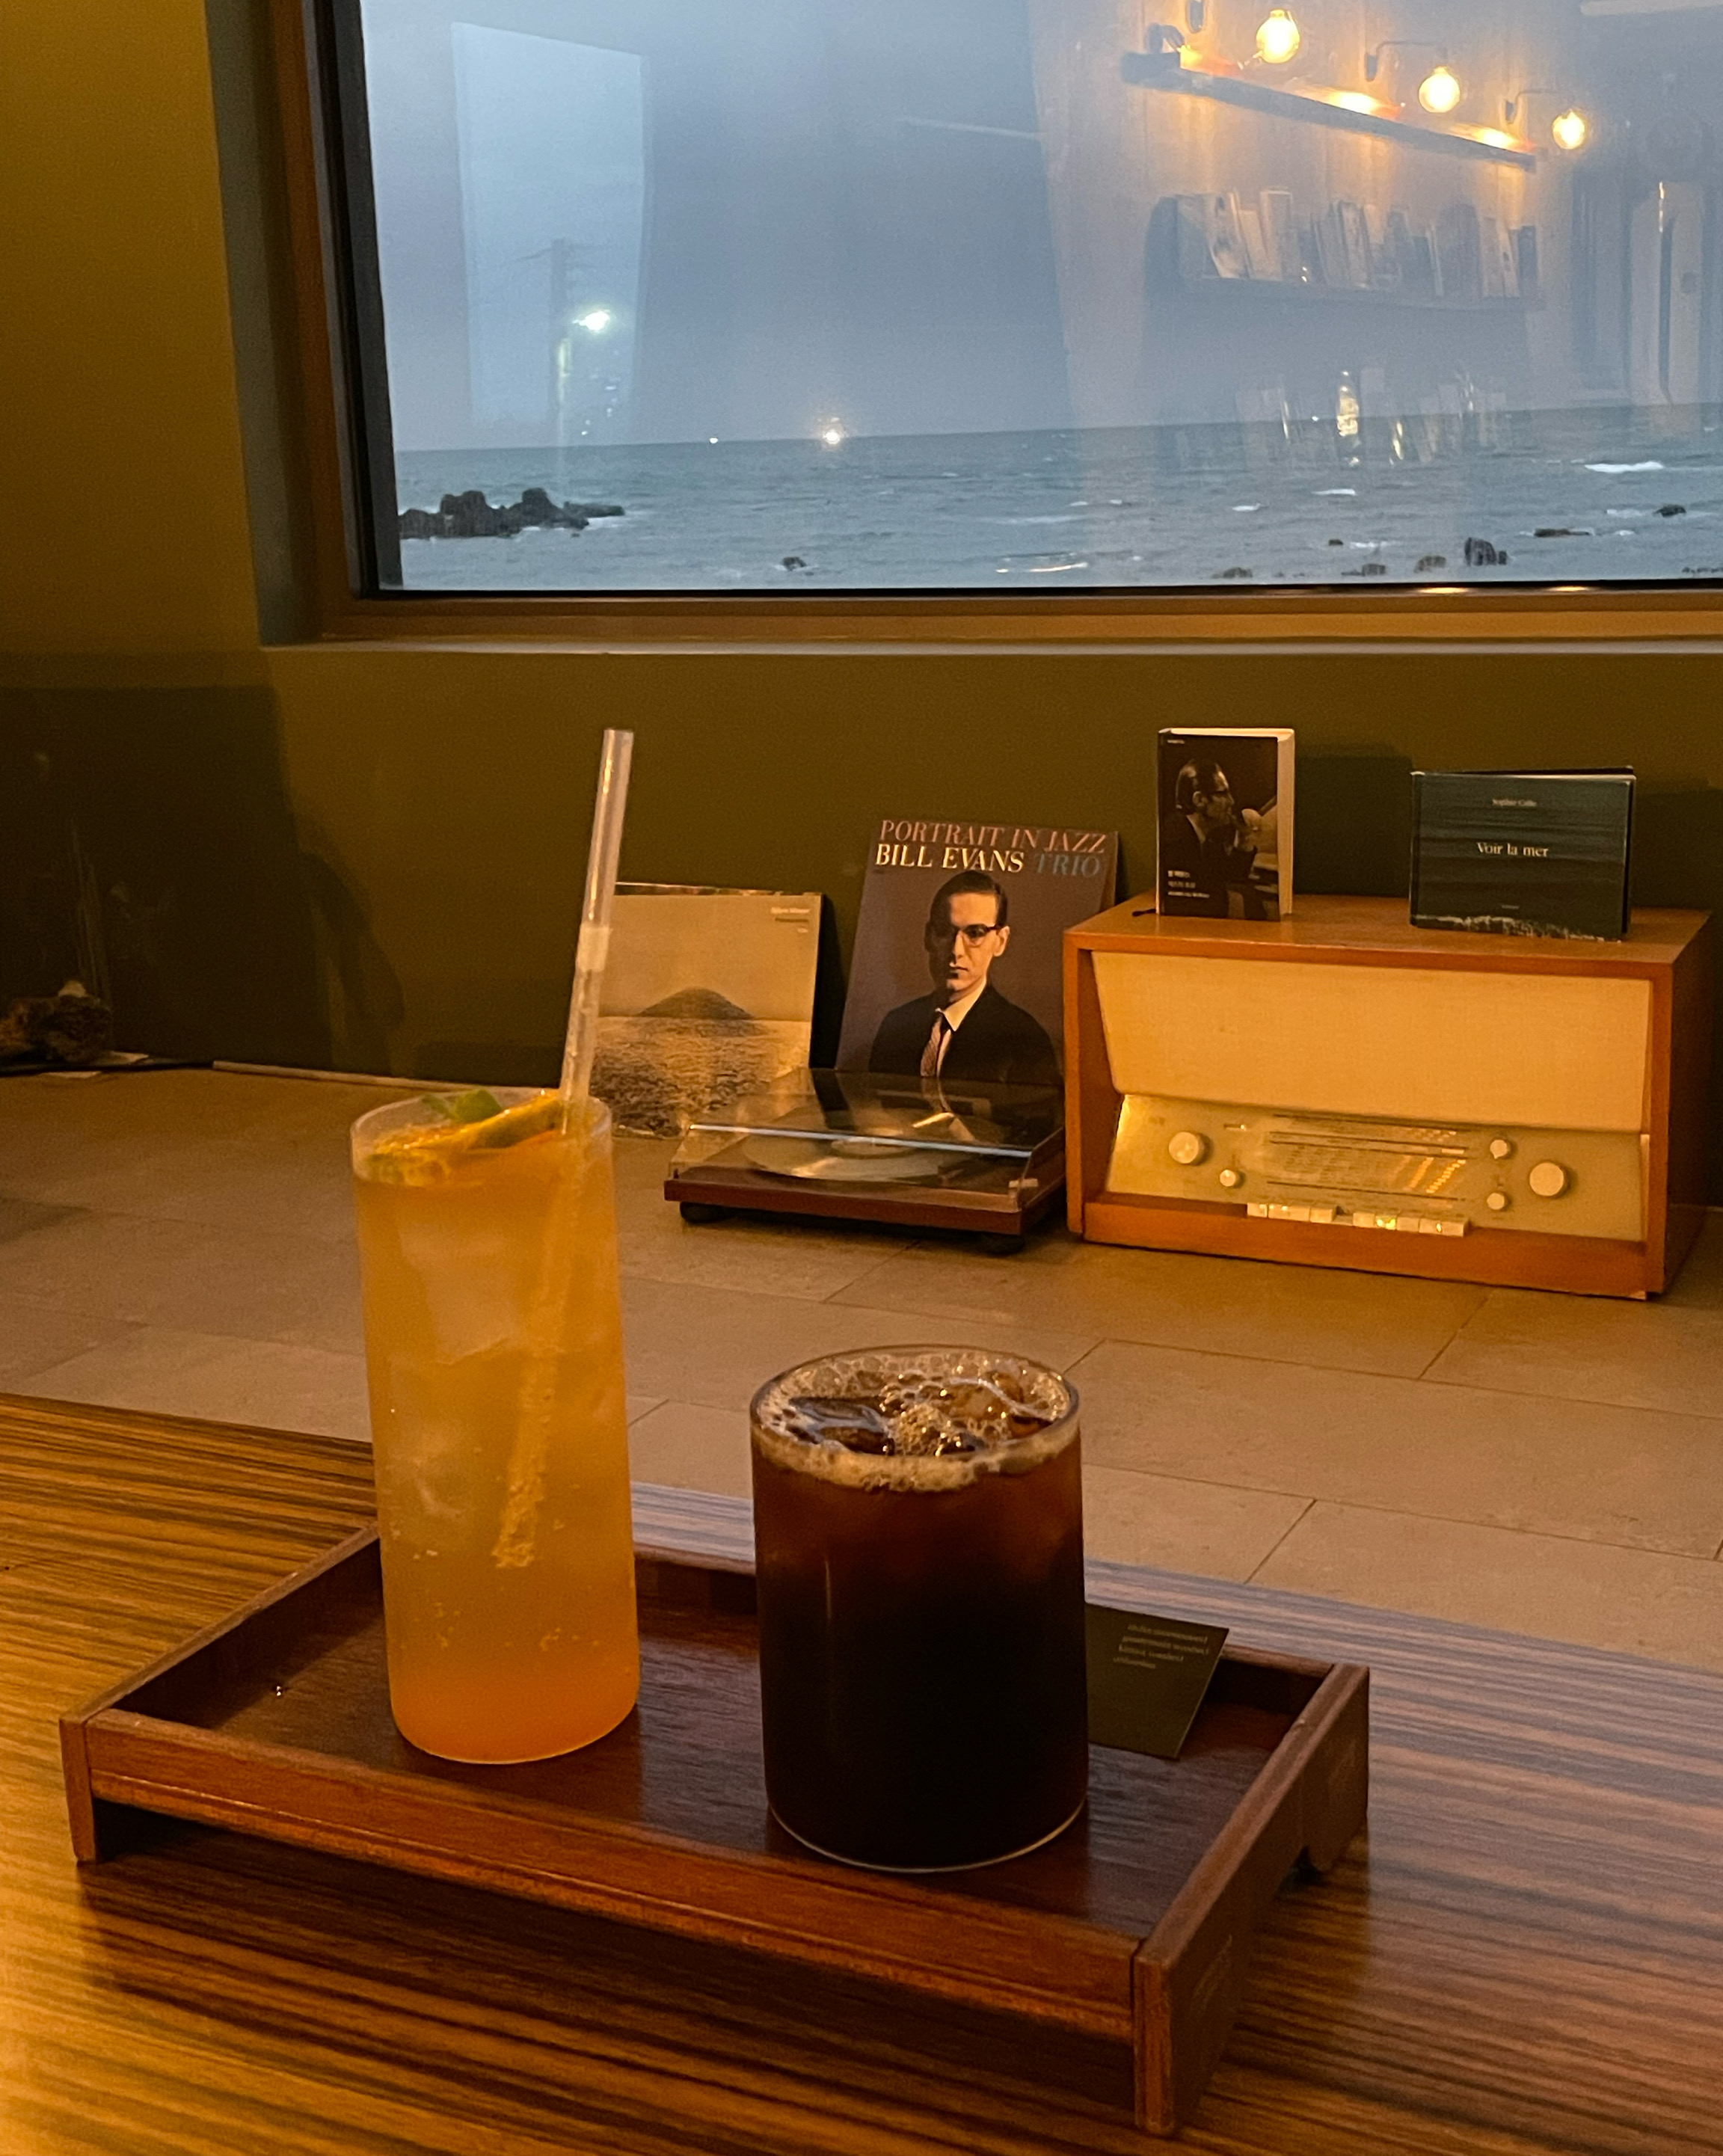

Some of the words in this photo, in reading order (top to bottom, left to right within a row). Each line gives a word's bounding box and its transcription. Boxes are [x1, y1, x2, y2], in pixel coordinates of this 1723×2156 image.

[880, 820, 1004, 847] PORTRAIT
[1011, 828, 1038, 848] IN
[1043, 831, 1107, 854] JAZZ
[1476, 842, 1503, 855] Voir
[1507, 843, 1518, 856] la
[1523, 847, 1549, 858] mer
[875, 844, 933, 867] BILL
[942, 847, 1024, 873] EVANS
[1036, 853, 1101, 877] TRIO
